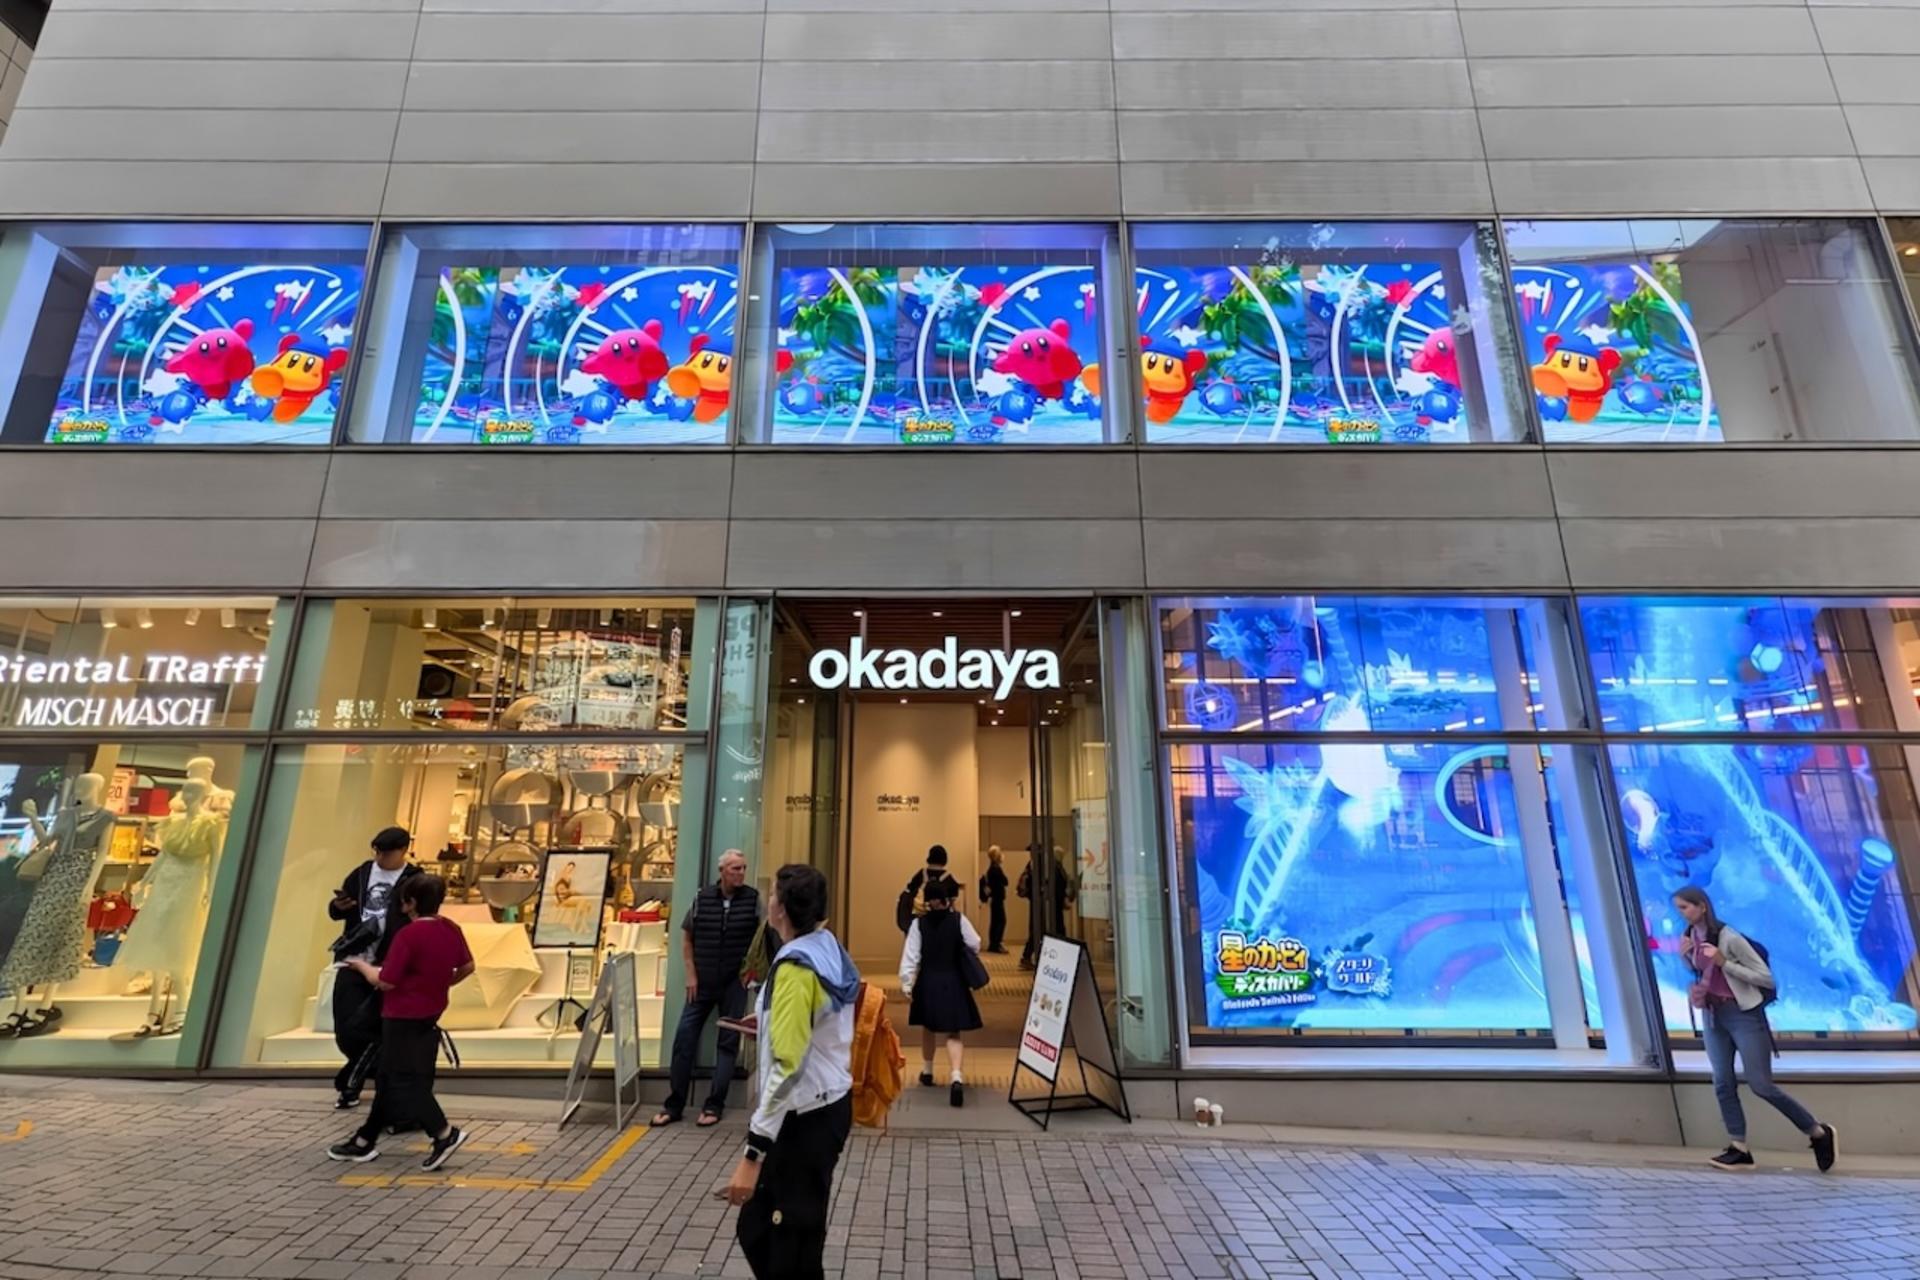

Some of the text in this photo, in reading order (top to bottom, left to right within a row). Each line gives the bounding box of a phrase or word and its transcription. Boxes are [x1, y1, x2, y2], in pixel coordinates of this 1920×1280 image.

[809, 636, 1060, 700] okadaya
[16, 698, 214, 726] MISCH MASCH
[877, 794, 920, 806] okadya
